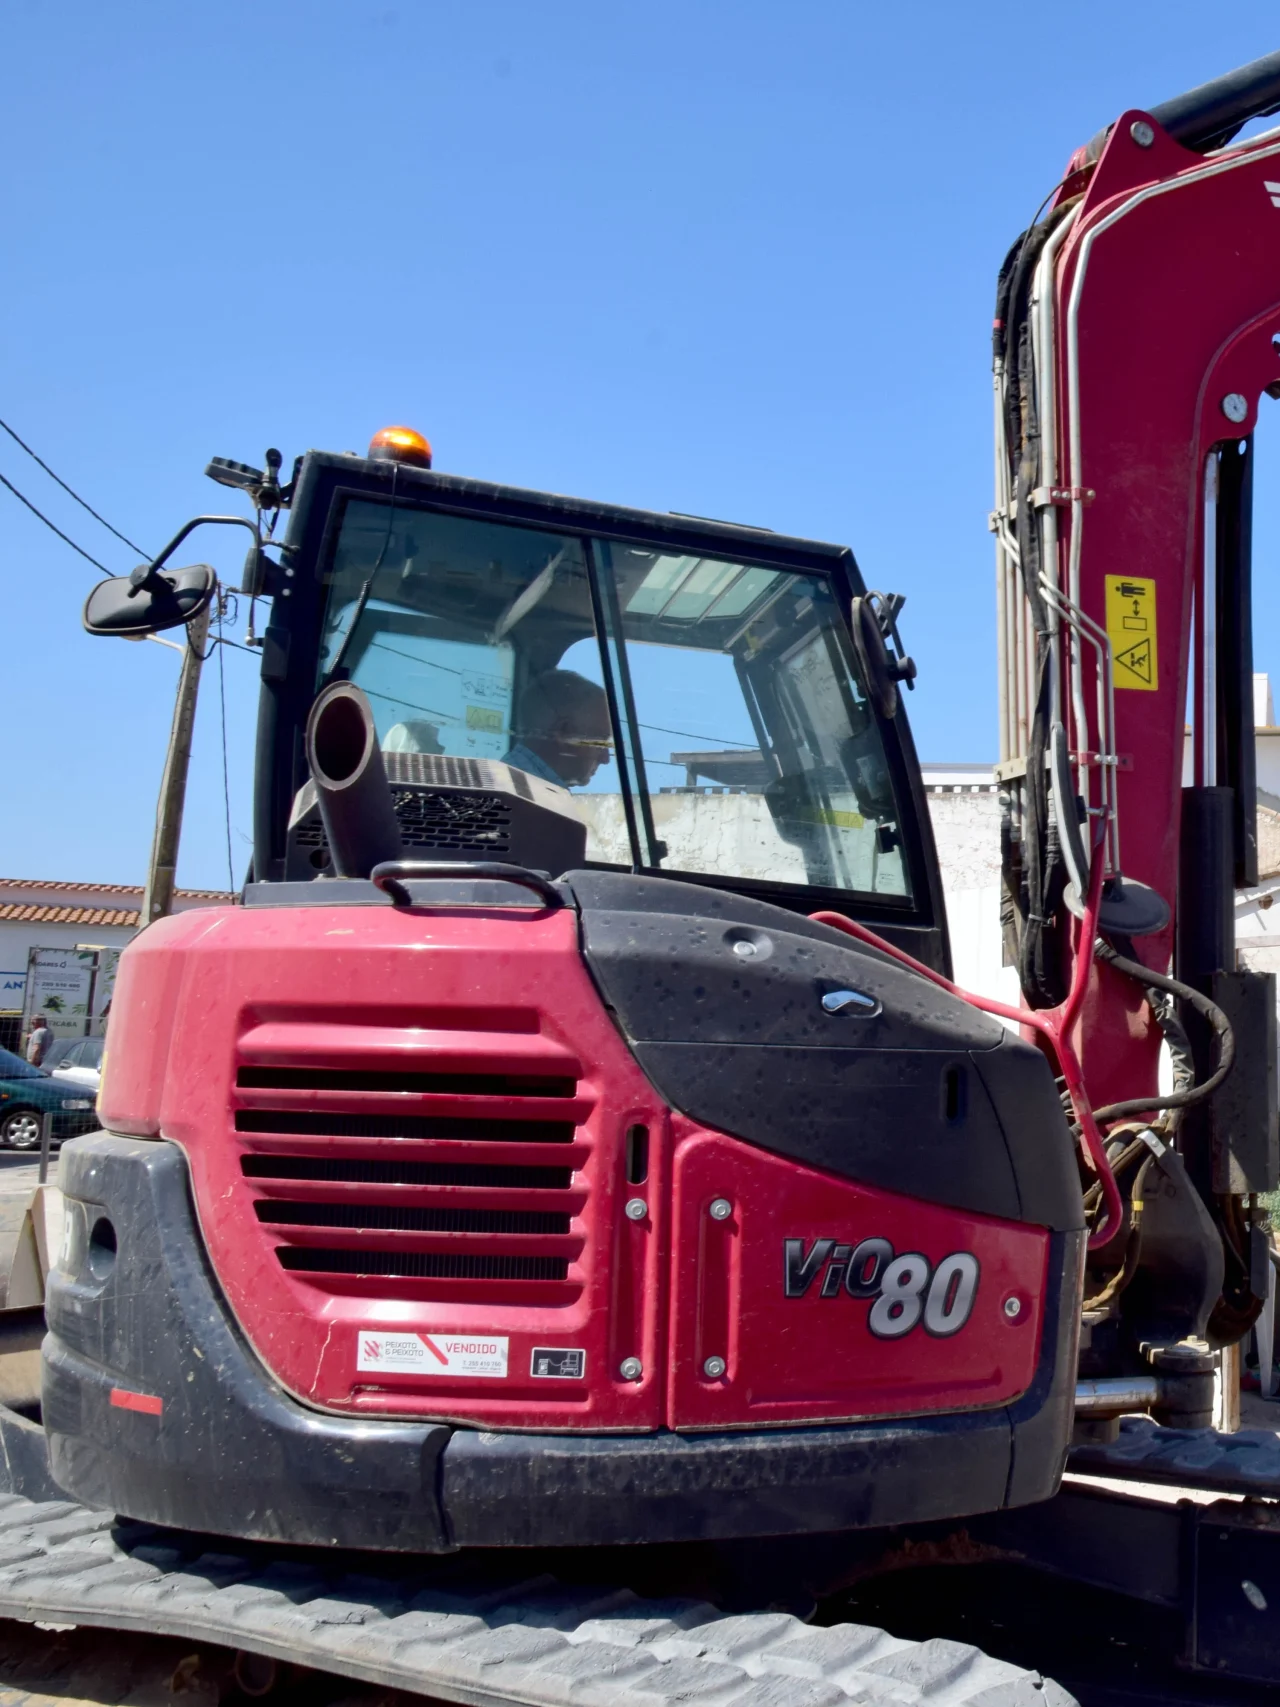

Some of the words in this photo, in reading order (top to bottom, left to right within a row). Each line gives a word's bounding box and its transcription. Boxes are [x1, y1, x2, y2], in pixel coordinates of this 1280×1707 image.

[385, 1341, 417, 1349] PEIXOTO
[445, 1343, 497, 1354] VENDIDO
[392, 1349, 423, 1357] PEIXOTO
